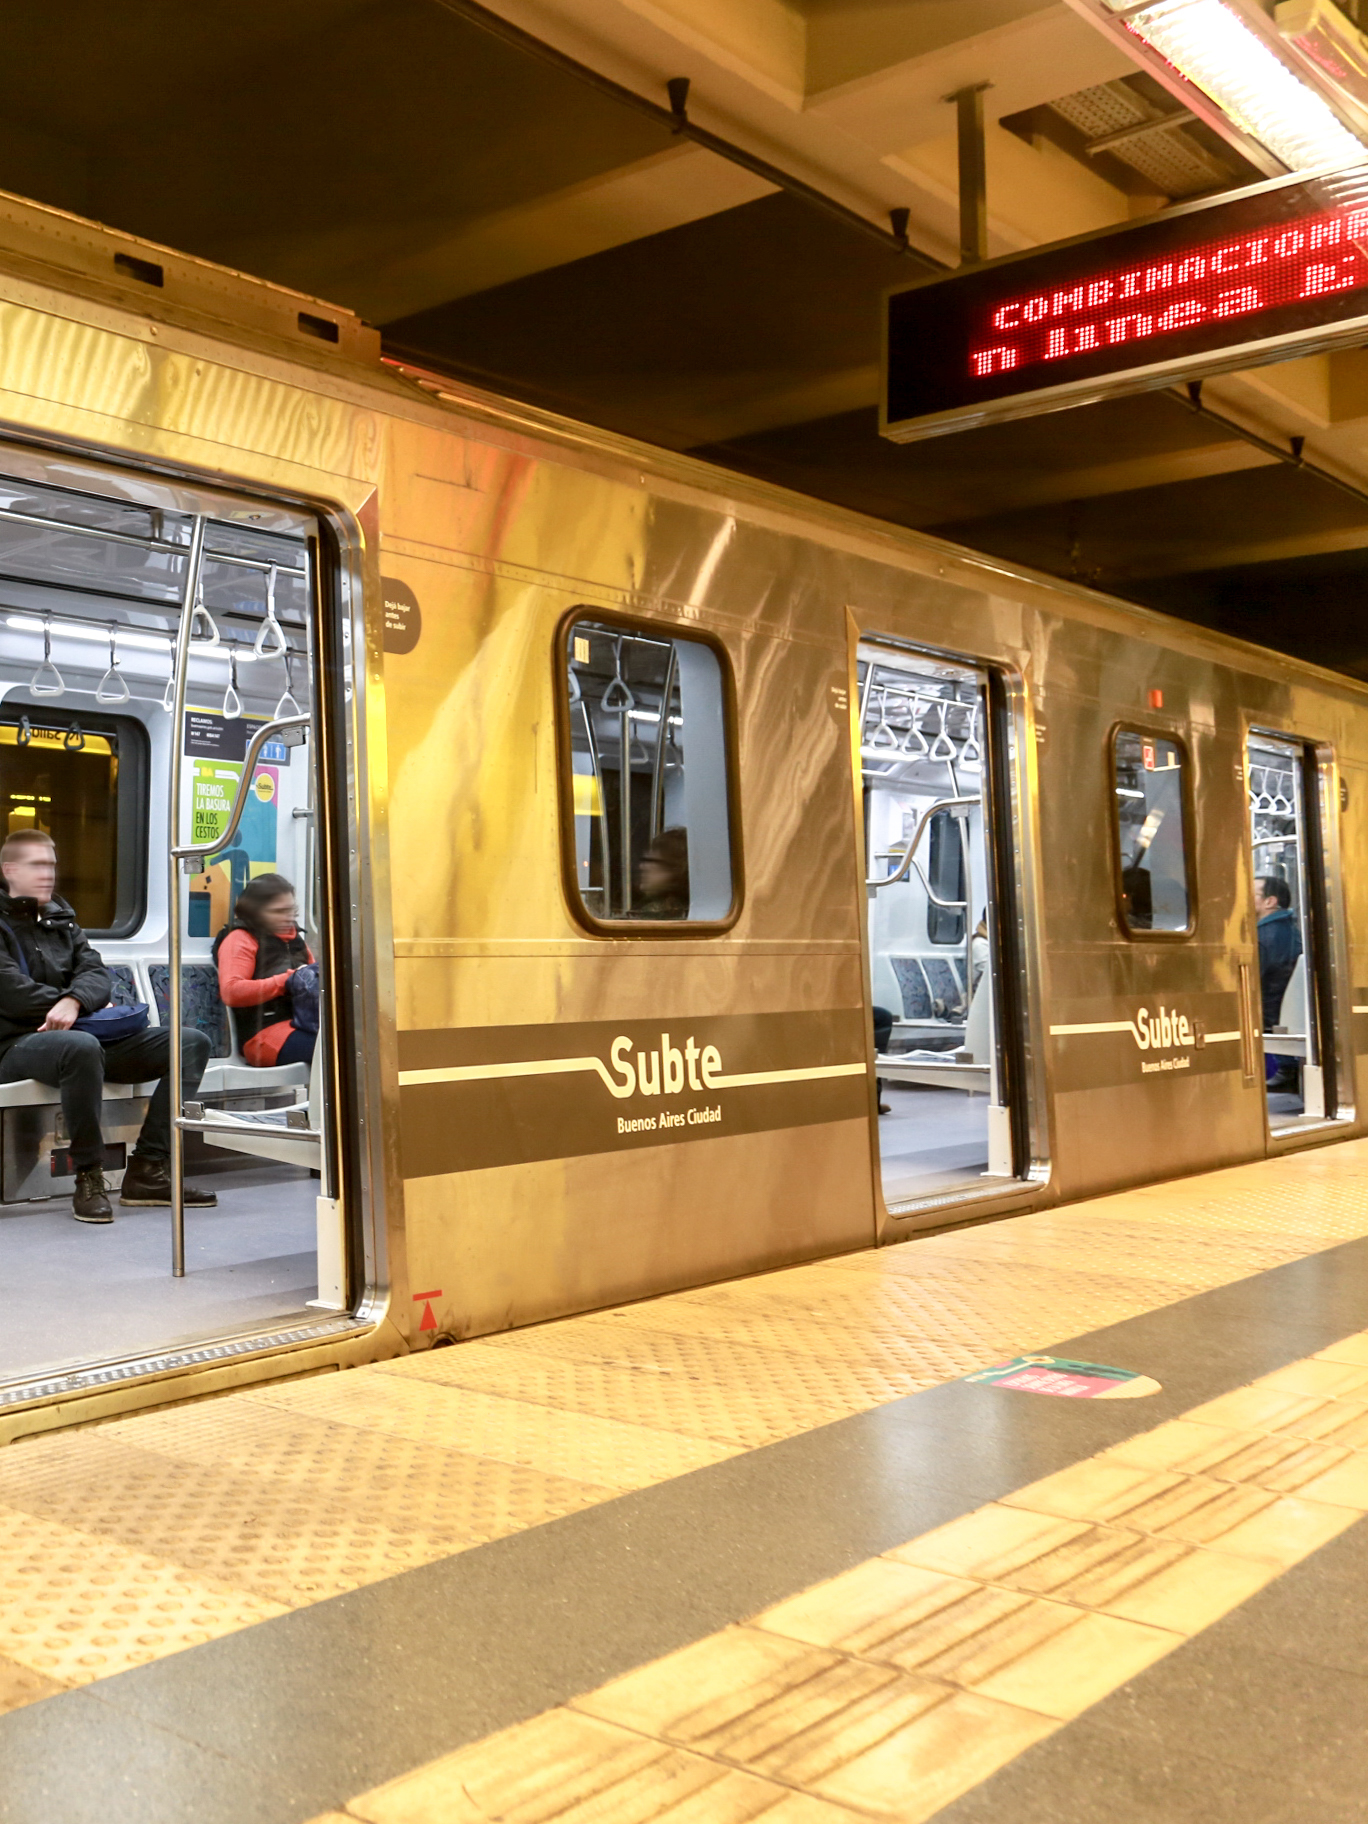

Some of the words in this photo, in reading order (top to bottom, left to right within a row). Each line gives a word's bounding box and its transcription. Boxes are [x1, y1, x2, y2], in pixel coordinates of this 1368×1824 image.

[1044, 286, 1264, 359] linea
[196, 783, 224, 798] TIREMOS
[196, 797, 205, 810] LA
[206, 798, 231, 811] BASURA
[196, 812, 205, 825] EN
[206, 812, 218, 825] LOS
[195, 825, 219, 839] CESTOS
[1136, 1006, 1191, 1050] Subte
[610, 1033, 723, 1098] Subte
[617, 1117, 657, 1133] Buenos
[659, 1111, 685, 1128] Aires
[687, 1105, 721, 1125] Ciudad
